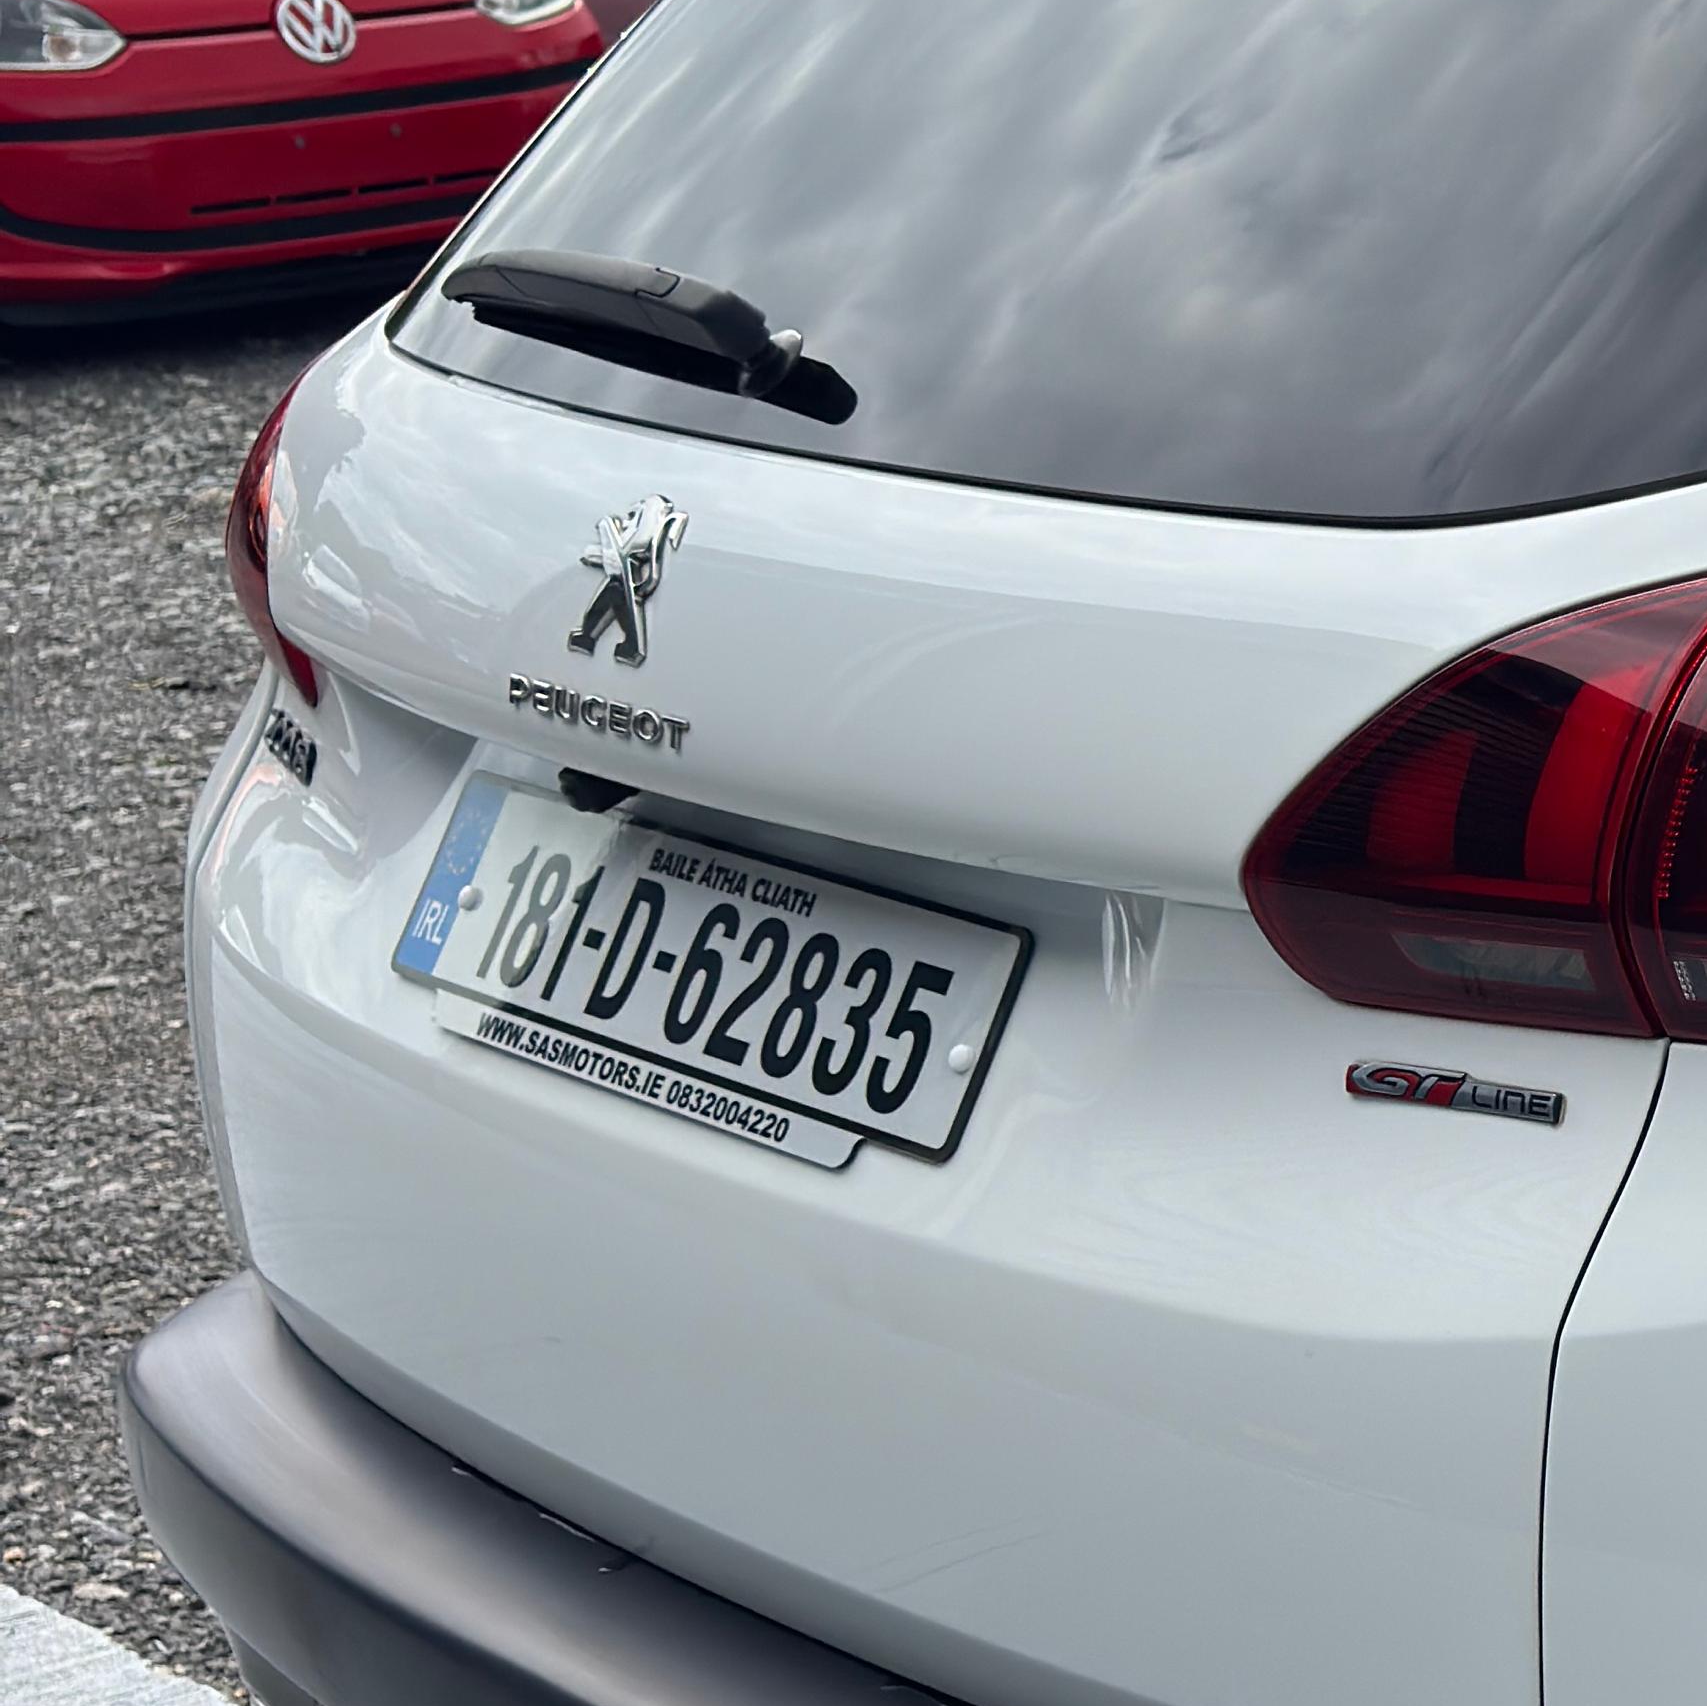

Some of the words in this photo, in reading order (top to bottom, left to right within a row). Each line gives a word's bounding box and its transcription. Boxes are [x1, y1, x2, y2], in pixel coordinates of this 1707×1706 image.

[508, 672, 690, 752] PEUGEOT
[648, 848, 701, 883] BAILE
[698, 858, 748, 898] ÁTHA
[751, 878, 817, 918] CLIATH
[411, 902, 446, 945] IRL
[476, 845, 955, 1115] 181-D-62835
[476, 1012, 664, 1101] WWW.SASMOTORS.IE
[664, 1082, 791, 1144] 0832004220
[1350, 1059, 1468, 1101] GT
[1471, 1085, 1552, 1118] LINE
